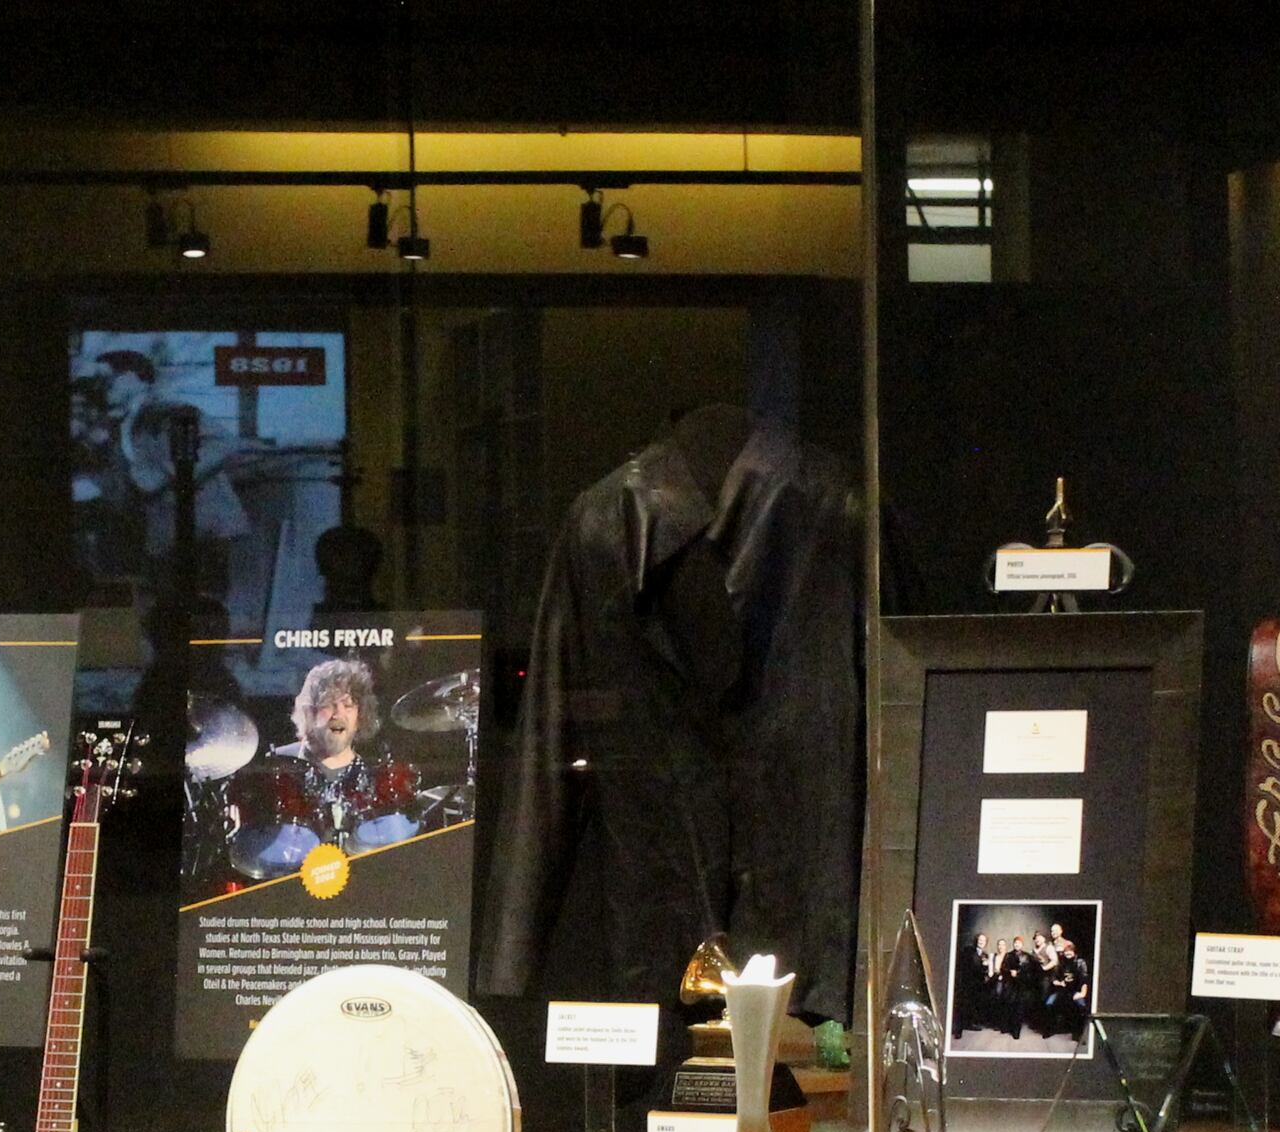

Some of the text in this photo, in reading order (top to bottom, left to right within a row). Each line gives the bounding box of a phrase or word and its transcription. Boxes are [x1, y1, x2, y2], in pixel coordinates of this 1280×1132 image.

[274, 630, 393, 649] CHRIS FRYAR
[346, 1002, 386, 1013] EVANS
